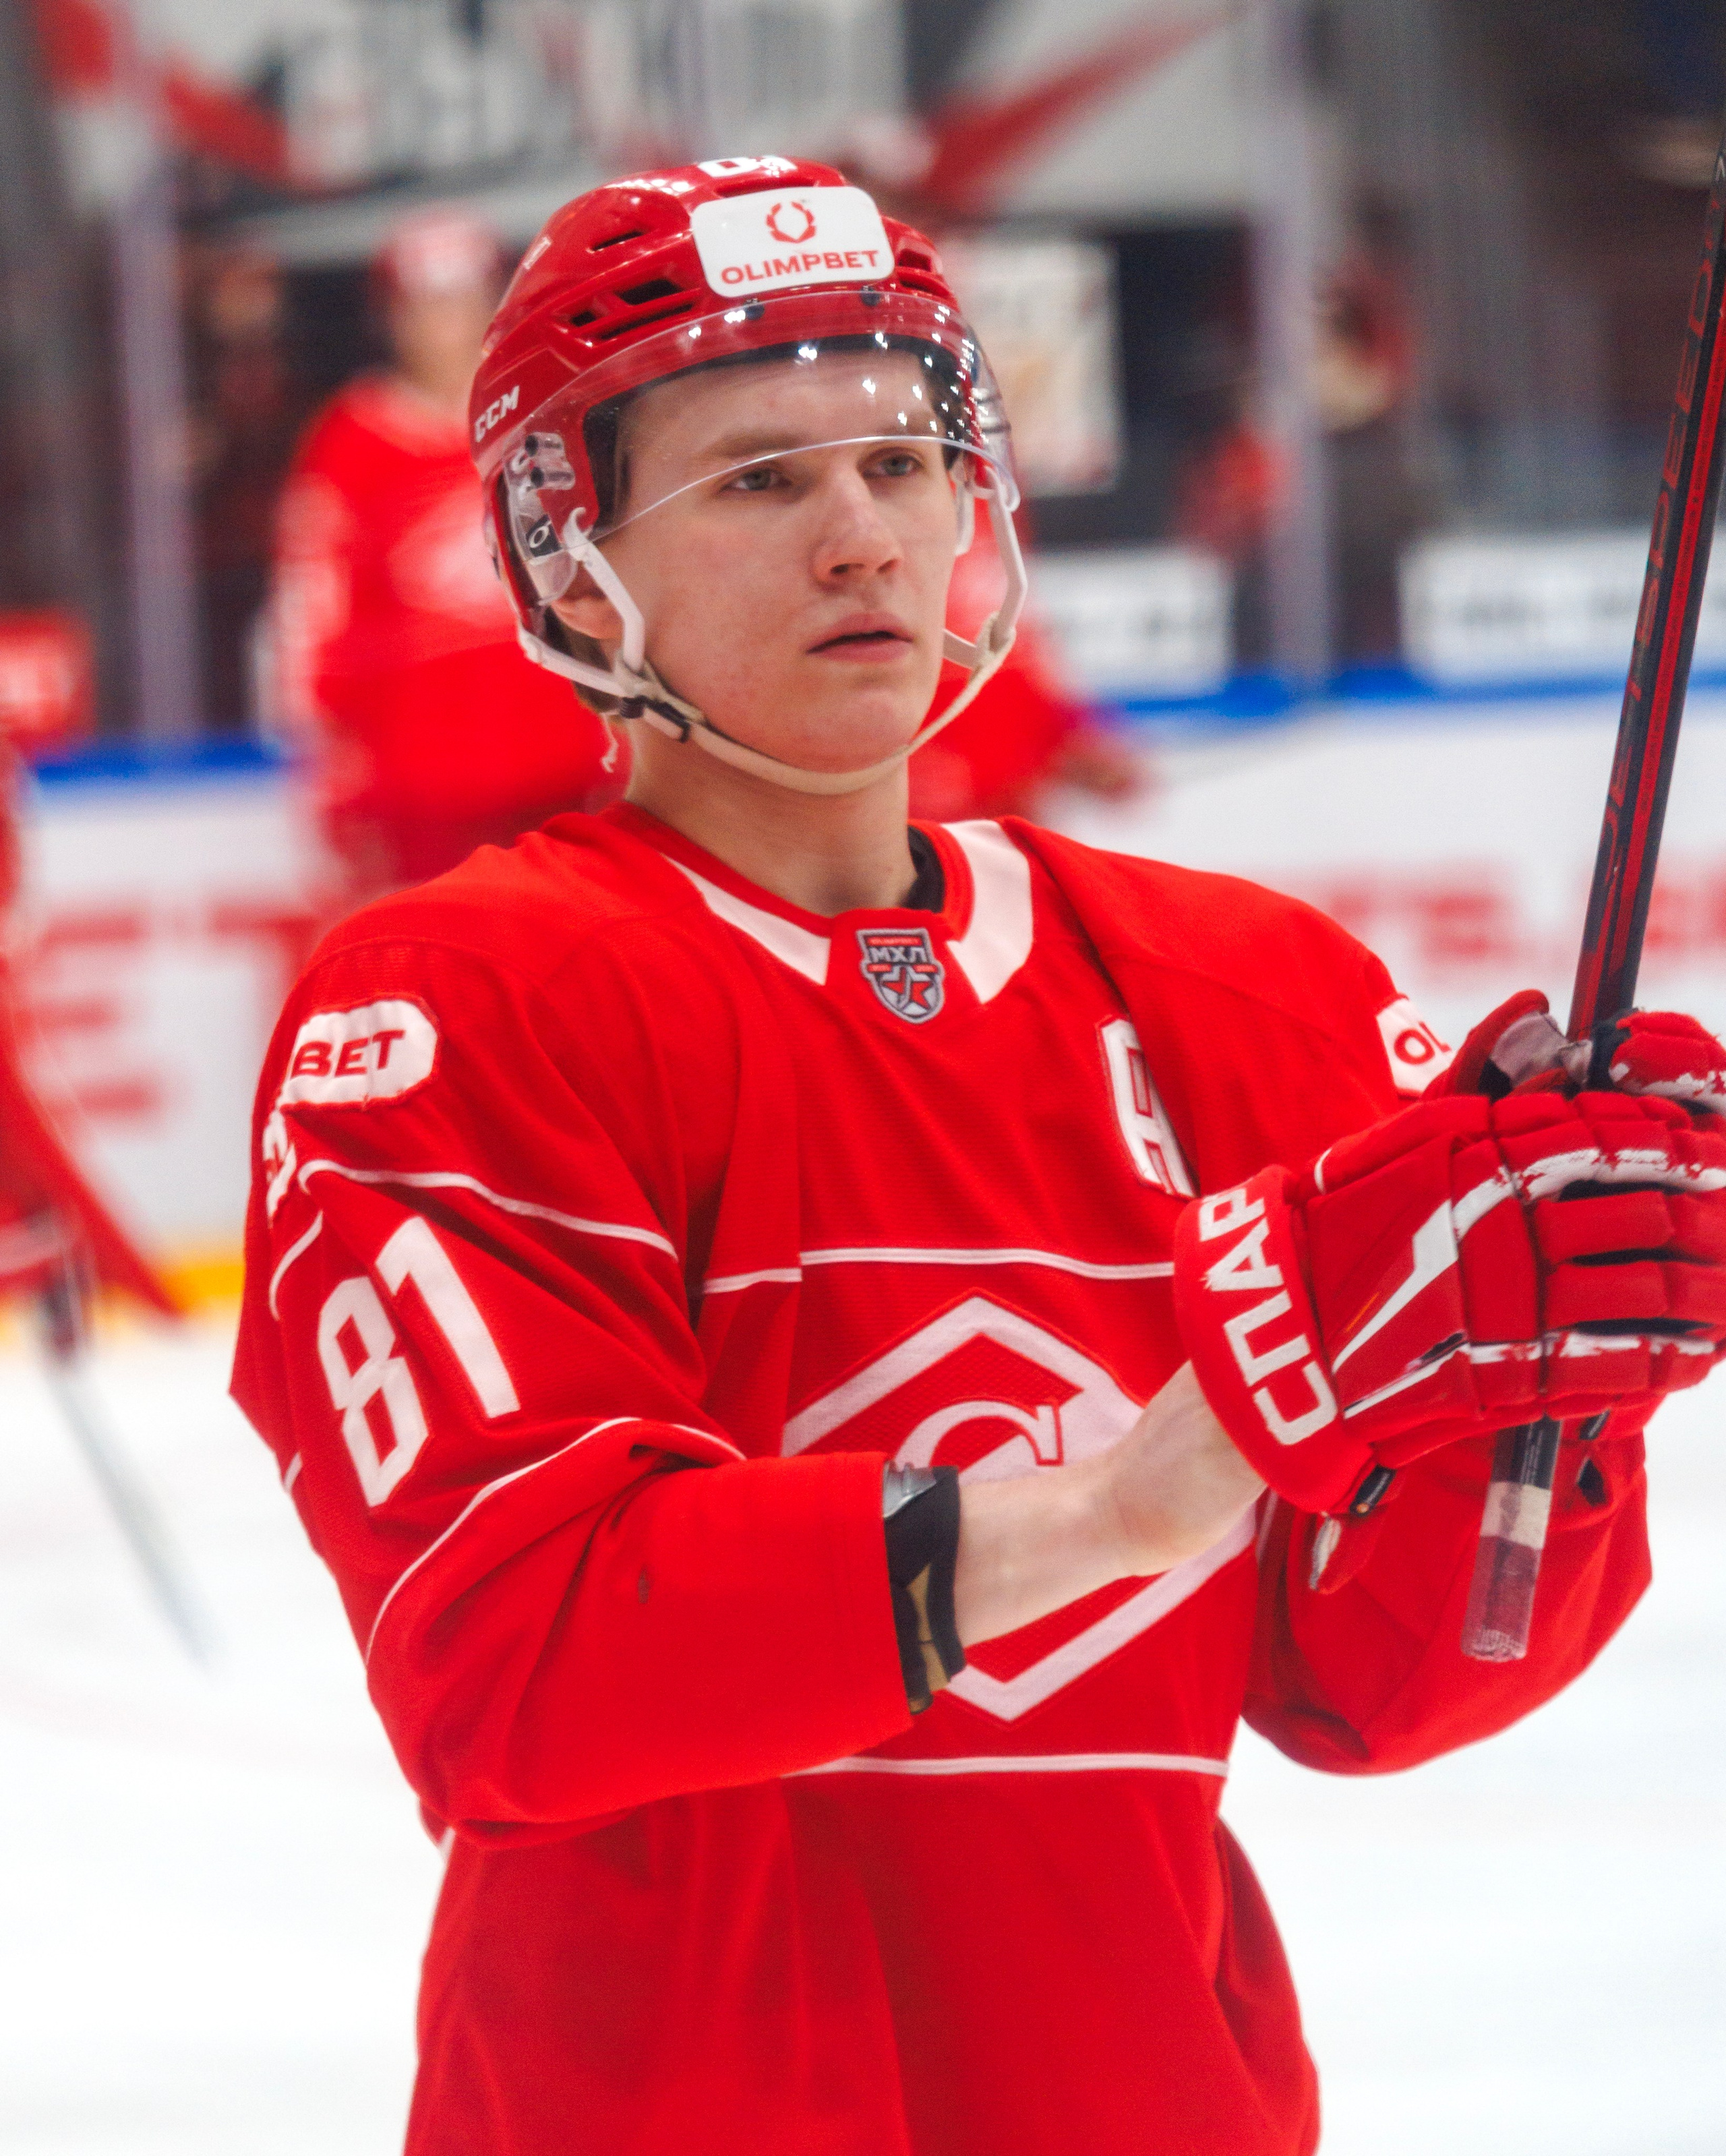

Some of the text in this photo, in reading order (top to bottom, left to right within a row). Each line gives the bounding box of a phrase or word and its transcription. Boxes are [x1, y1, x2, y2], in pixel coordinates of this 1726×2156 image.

[720, 250, 879, 284] OLIMPBET
[474, 386, 520, 442] CCM
[869, 947, 928, 963] МХЛ
[291, 1029, 405, 1079] BET
[318, 1216, 520, 1508] 81
